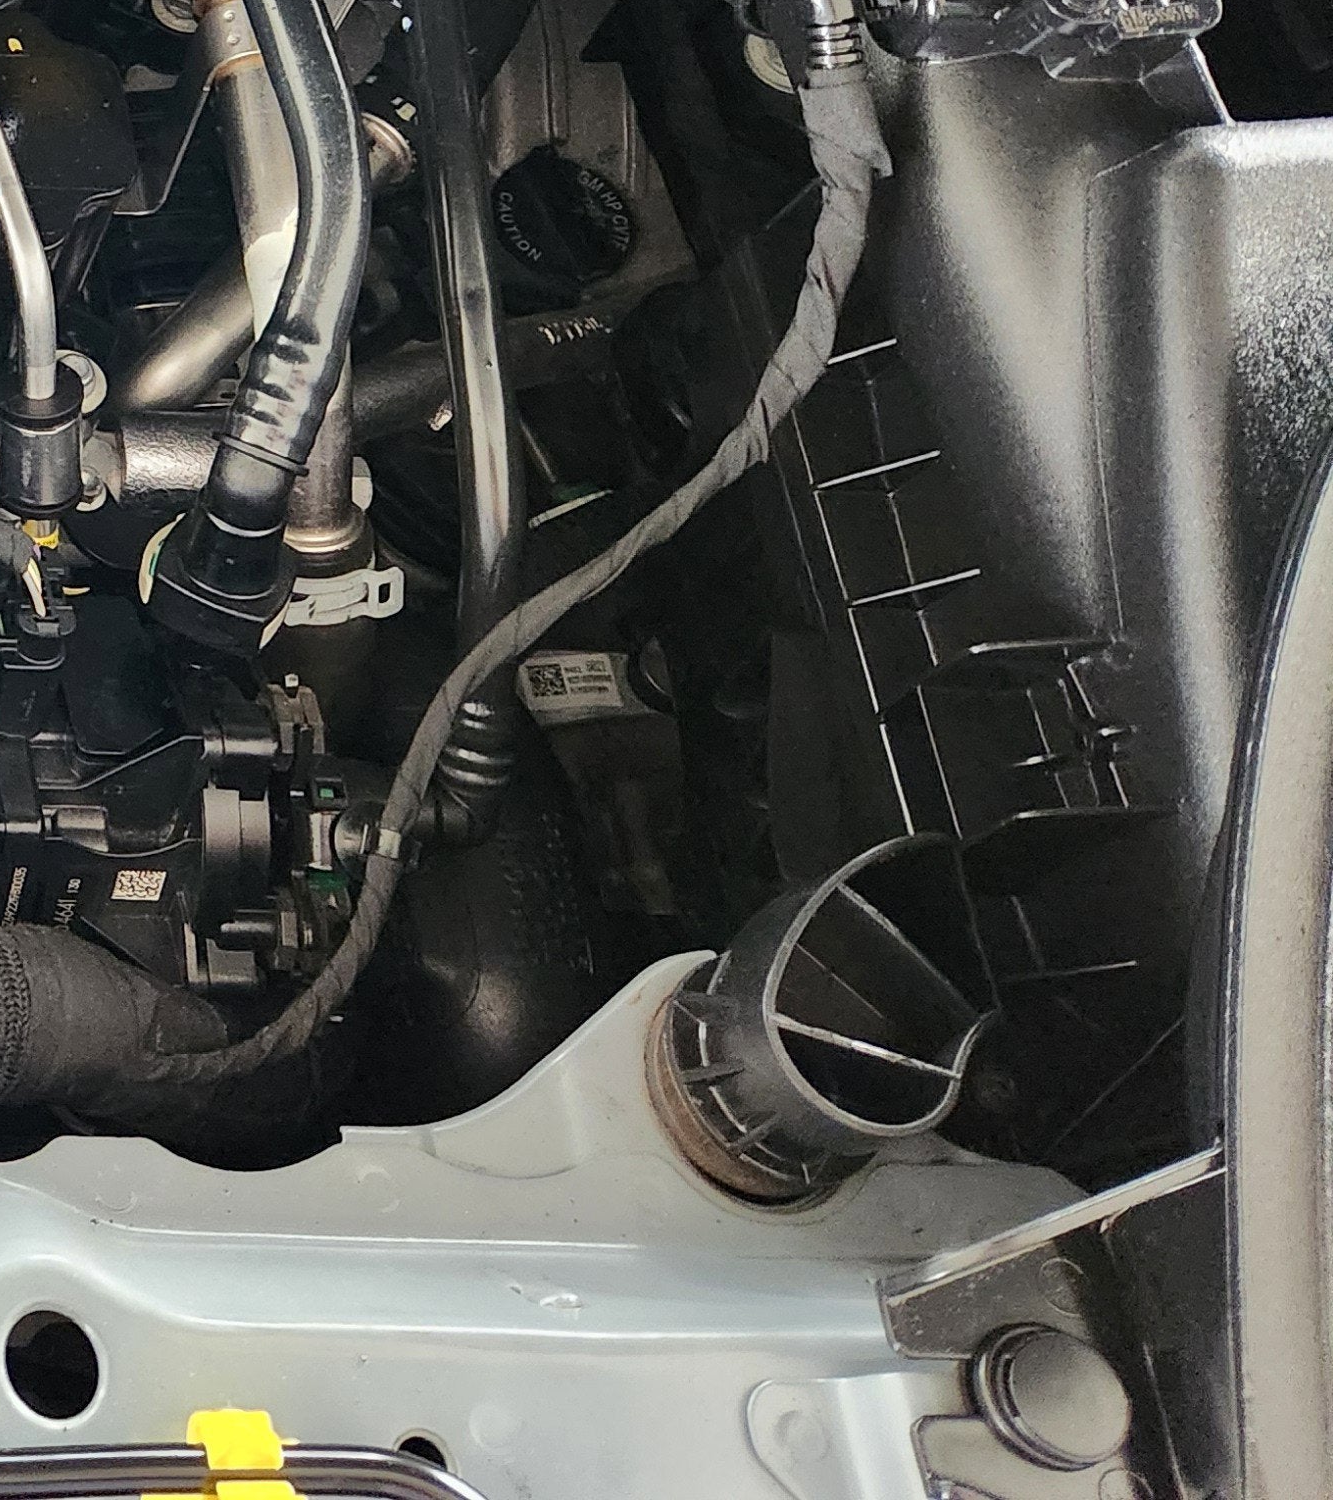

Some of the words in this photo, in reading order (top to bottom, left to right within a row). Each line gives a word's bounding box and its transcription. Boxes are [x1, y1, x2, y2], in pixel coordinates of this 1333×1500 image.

[578, 170, 605, 193] GM
[600, 190, 624, 211] HP
[498, 191, 542, 262] CAUTION
